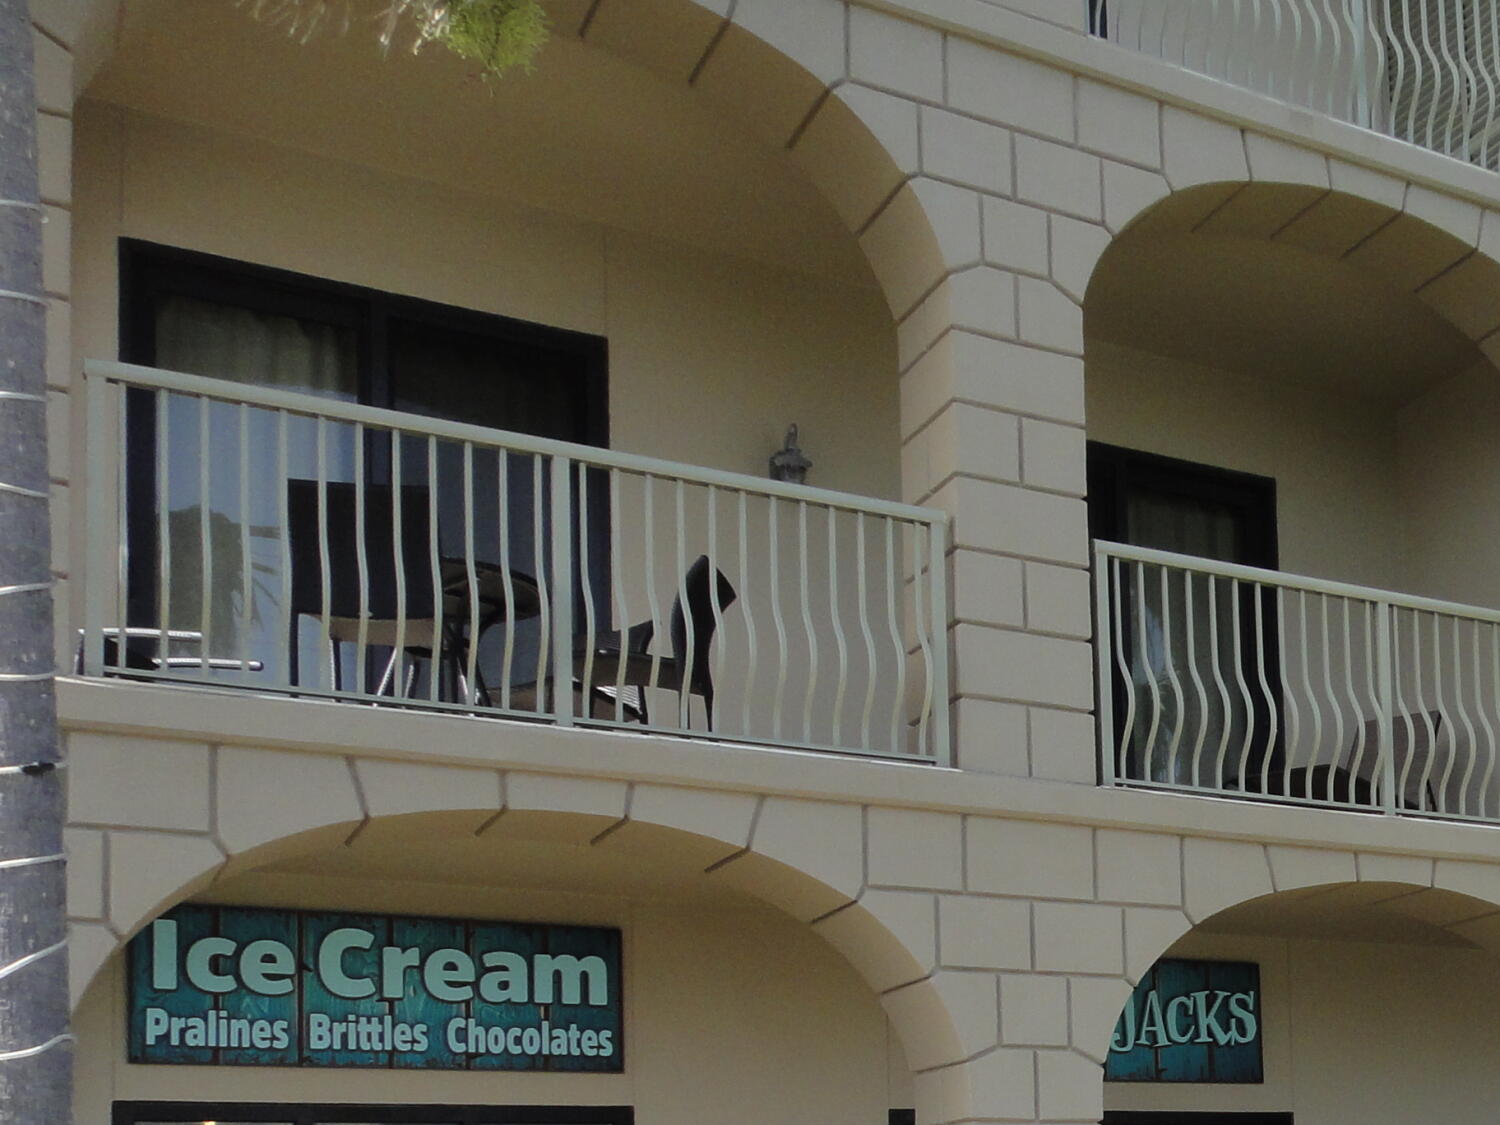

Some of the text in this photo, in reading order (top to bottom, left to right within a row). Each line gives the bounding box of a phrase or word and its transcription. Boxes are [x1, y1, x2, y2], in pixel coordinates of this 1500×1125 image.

[152, 918, 609, 1007] Ice Cream
[145, 1007, 614, 1058] Pralines Brittles Chocolates
[1110, 988, 1258, 1052] JACKS
